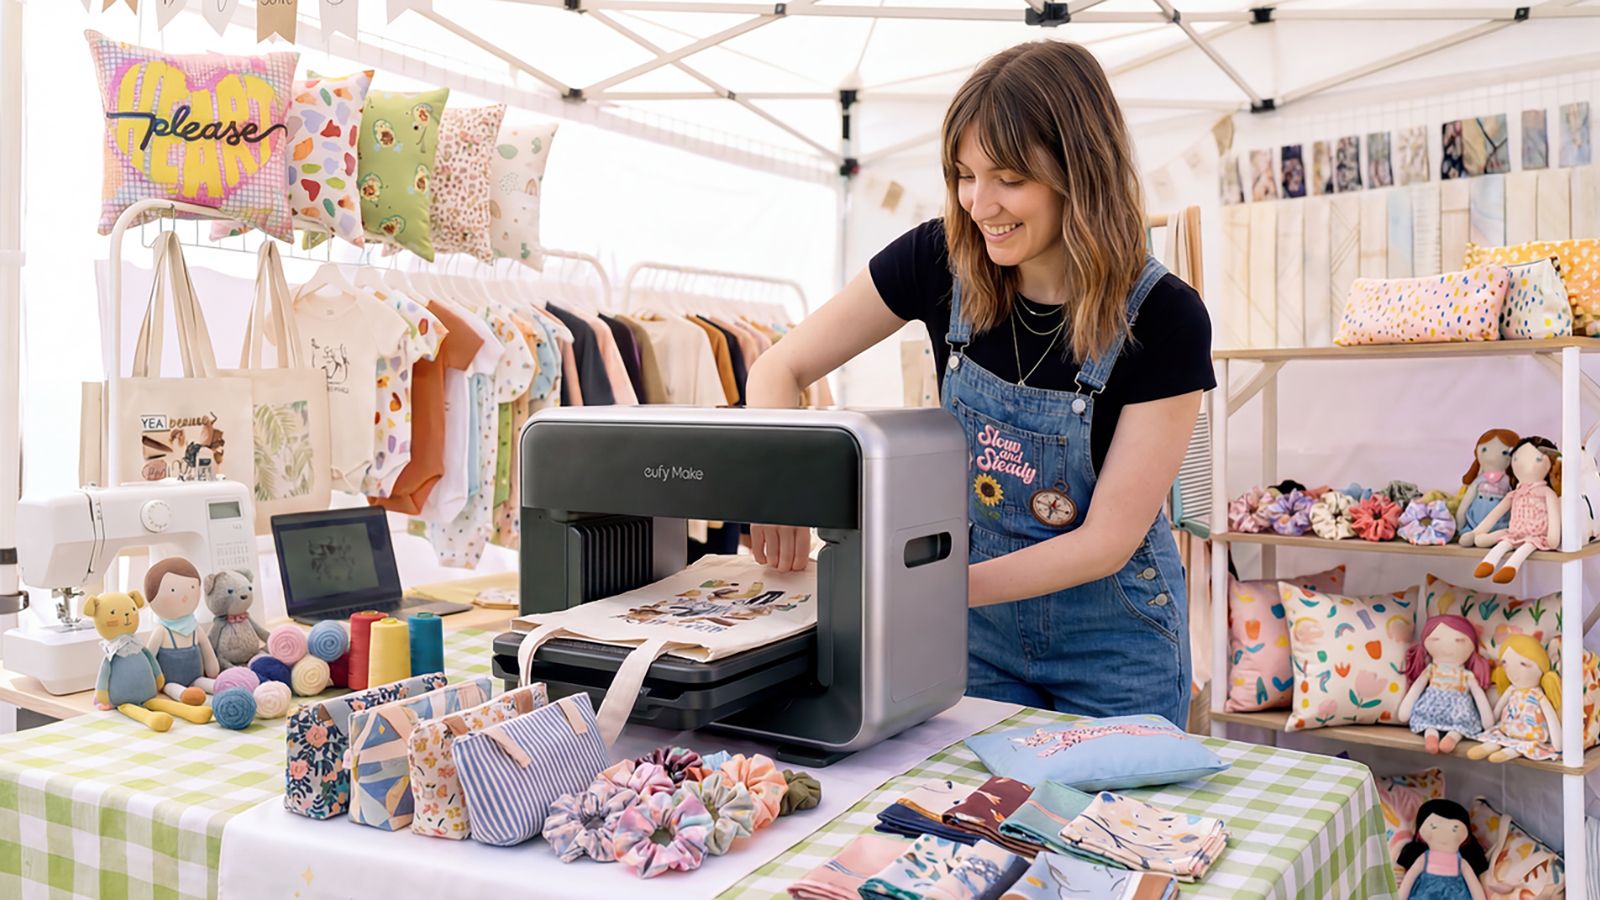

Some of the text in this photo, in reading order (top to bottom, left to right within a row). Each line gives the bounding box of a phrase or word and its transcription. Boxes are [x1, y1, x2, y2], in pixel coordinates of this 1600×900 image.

[106, 105, 288, 151] please
[141, 418, 164, 429] YEA
[977, 424, 1021, 454] Slow
[976, 447, 1037, 485] Steady
[999, 449, 1024, 464] and
[643, 464, 704, 482] eufy Make
